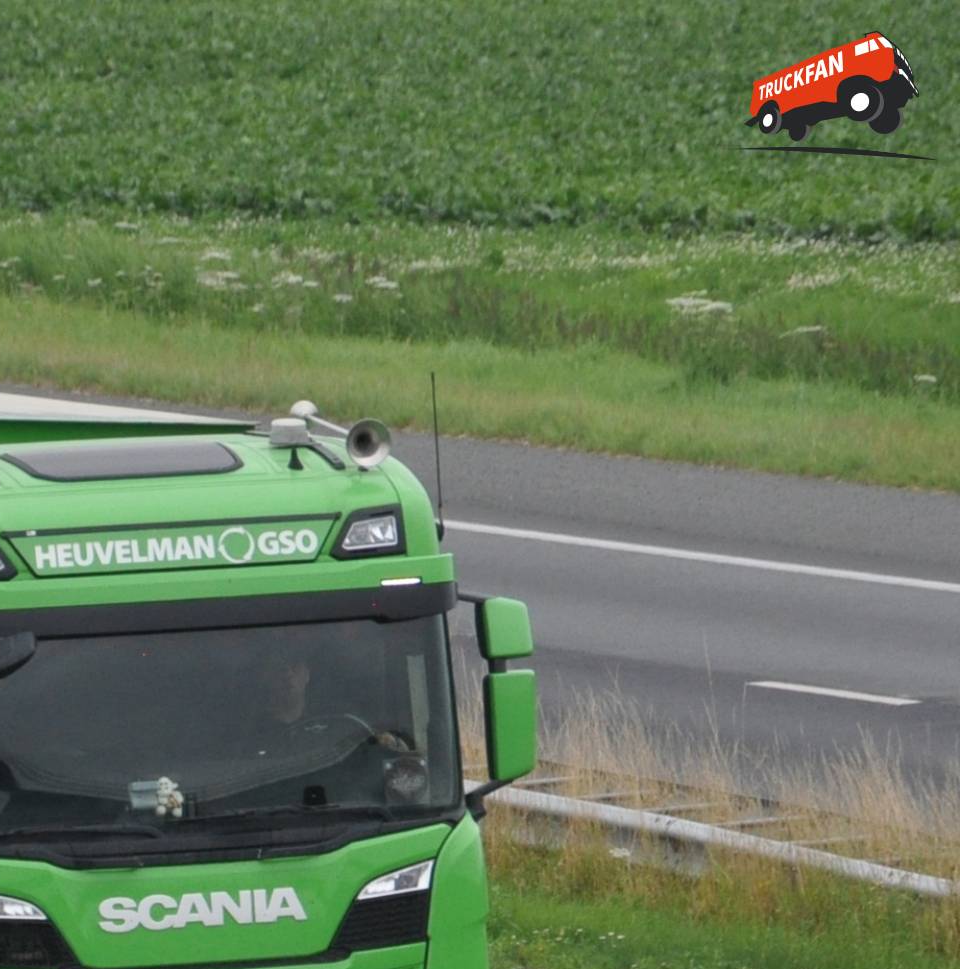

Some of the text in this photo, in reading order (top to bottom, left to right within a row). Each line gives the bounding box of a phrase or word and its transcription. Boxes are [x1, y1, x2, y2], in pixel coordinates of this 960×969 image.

[34, 529, 318, 569] HEUVELMAN GSO
[98, 886, 307, 933] SCANIA
